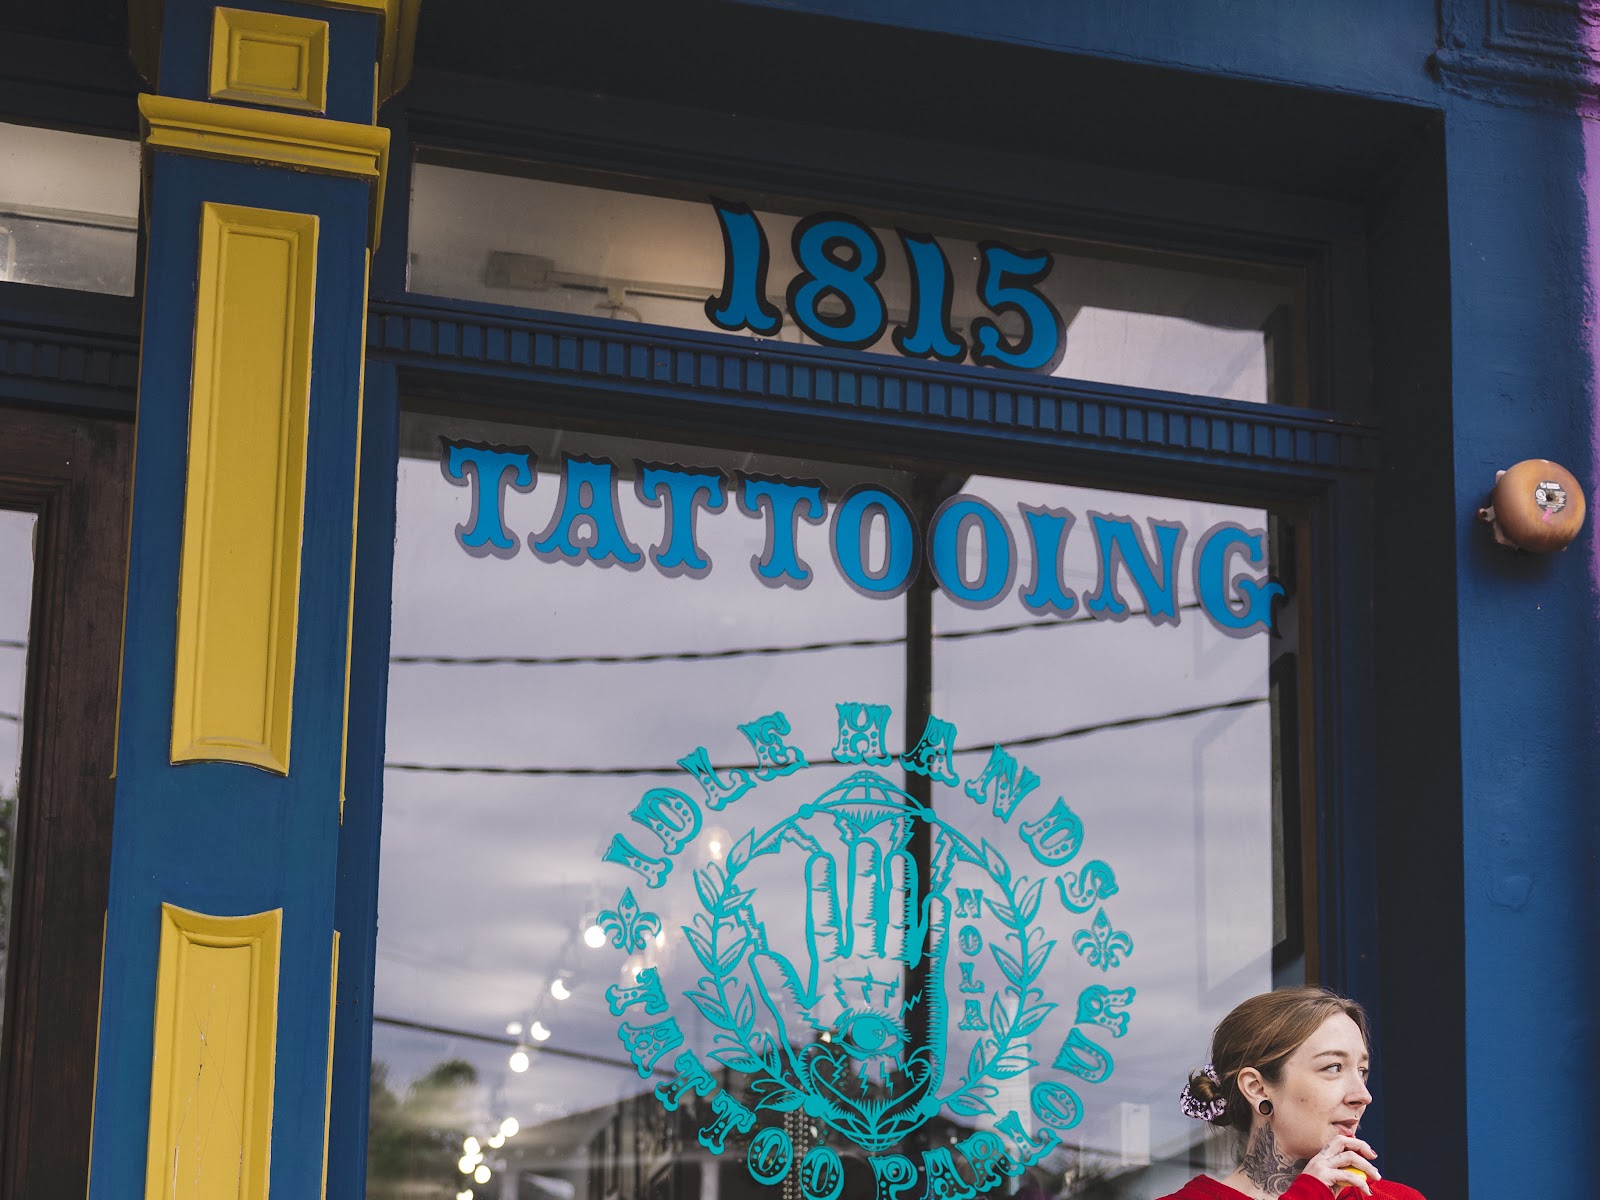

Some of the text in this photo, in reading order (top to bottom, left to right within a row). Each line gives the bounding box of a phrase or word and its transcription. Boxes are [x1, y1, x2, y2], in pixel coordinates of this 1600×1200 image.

[706, 199, 1066, 376] 1815
[440, 436, 1285, 638] TATTOOING
[602, 702, 1119, 914] IDLE HANDS
[955, 887, 990, 1032] NOLA
